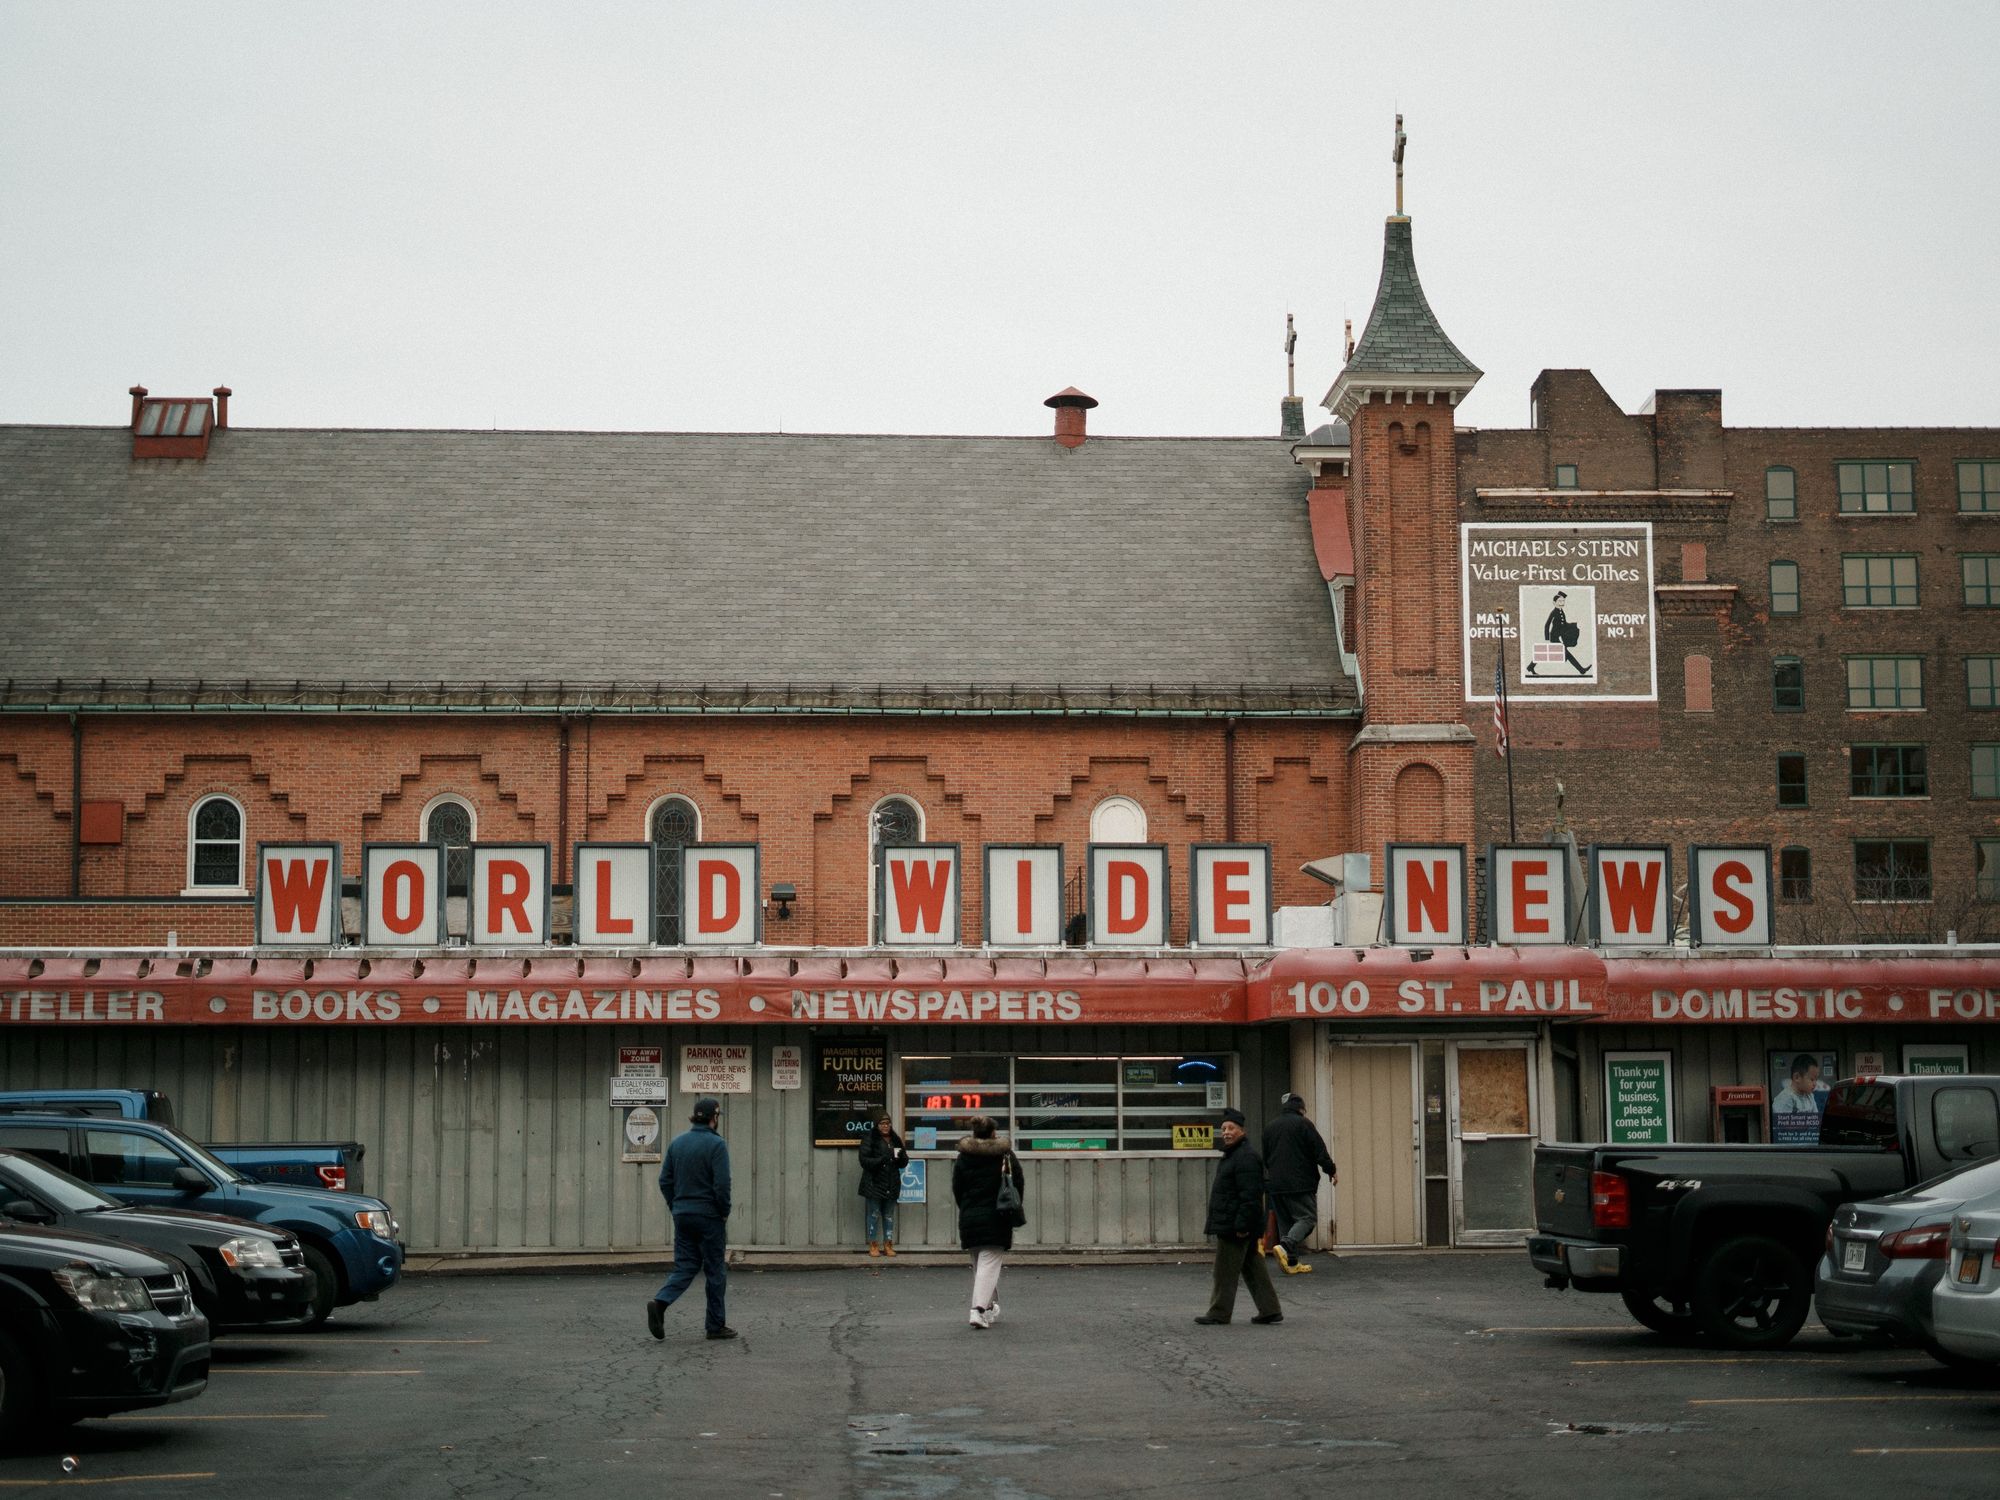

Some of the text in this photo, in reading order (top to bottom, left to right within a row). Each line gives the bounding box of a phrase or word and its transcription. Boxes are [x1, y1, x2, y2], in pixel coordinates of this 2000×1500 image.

[1572, 563, 1640, 582] Clothes
[1598, 614, 1646, 625] FACTORY
[1470, 627, 1518, 638] OFFICES
[1630, 627, 1634, 638] 1
[267, 859, 1754, 934] WORLD WIDE NEWS
[1288, 980, 1593, 1014] 100 ST. PAUL
[0, 988, 1082, 1021] TELLER BOOKS MAGAZINES NEWSPAPERS
[1652, 988, 1863, 1019] DOMESTIC
[687, 1048, 746, 1058] PARKING ONLY
[823, 1048, 883, 1056] IMAGINE YOUR
[774, 1059, 799, 1067] LOITERING
[824, 1058, 883, 1070] FUTURE
[1914, 1063, 1959, 1073] Thank you
[1613, 1067, 1659, 1078] Thank you
[1857, 1065, 1882, 1073] LOITERING
[837, 1082, 883, 1091] A CAREER
[1620, 1079, 1656, 1091] for your
[1618, 1092, 1660, 1103] business,
[1726, 1091, 1755, 1101] frontier
[1624, 1104, 1653, 1116] please
[846, 1121, 874, 1131] OAC
[1615, 1116, 1662, 1127] come back
[1176, 1128, 1209, 1137] ATM
[1627, 1129, 1652, 1139] soon!
